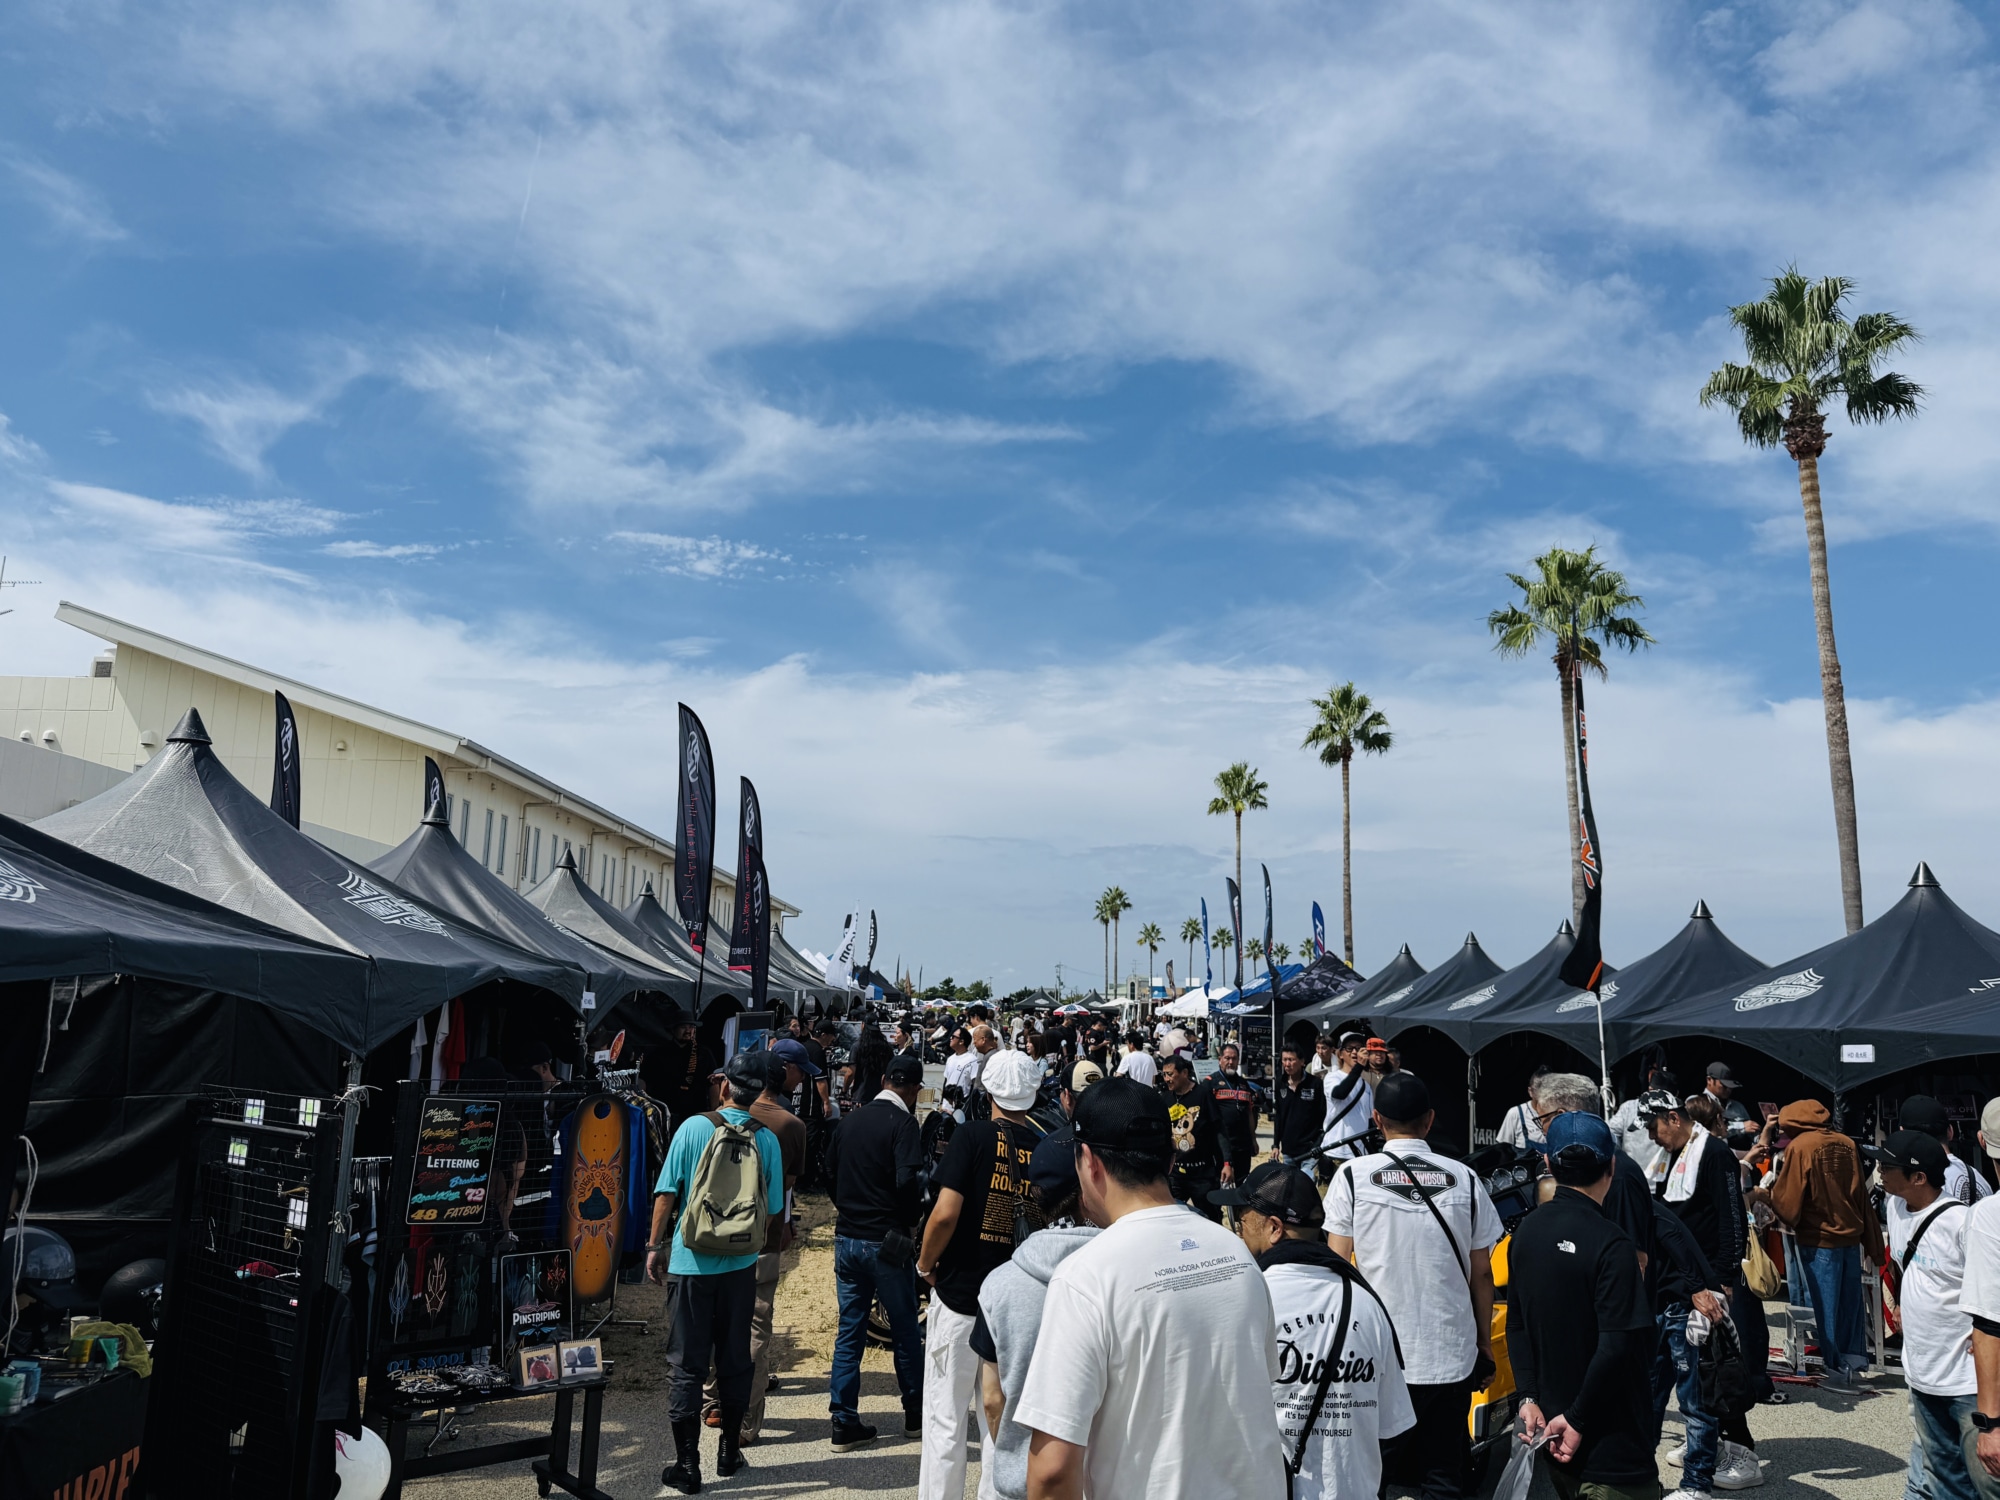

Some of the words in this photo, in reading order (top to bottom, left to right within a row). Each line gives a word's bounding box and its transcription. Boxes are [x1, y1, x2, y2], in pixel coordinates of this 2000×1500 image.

[996, 1141, 1032, 1165] RST
[1381, 1171, 1447, 1185] HARLEYAVIDSON
[465, 1187, 486, 1202] 72
[411, 1209, 438, 1220] 48
[1283, 1313, 1359, 1334] GENUIE
[1289, 1392, 1298, 1400] All
[1277, 1401, 1312, 1411] constructi
[1326, 1401, 1349, 1409] comfor
[1333, 1411, 1340, 1419] be
[1342, 1411, 1351, 1419] tru
